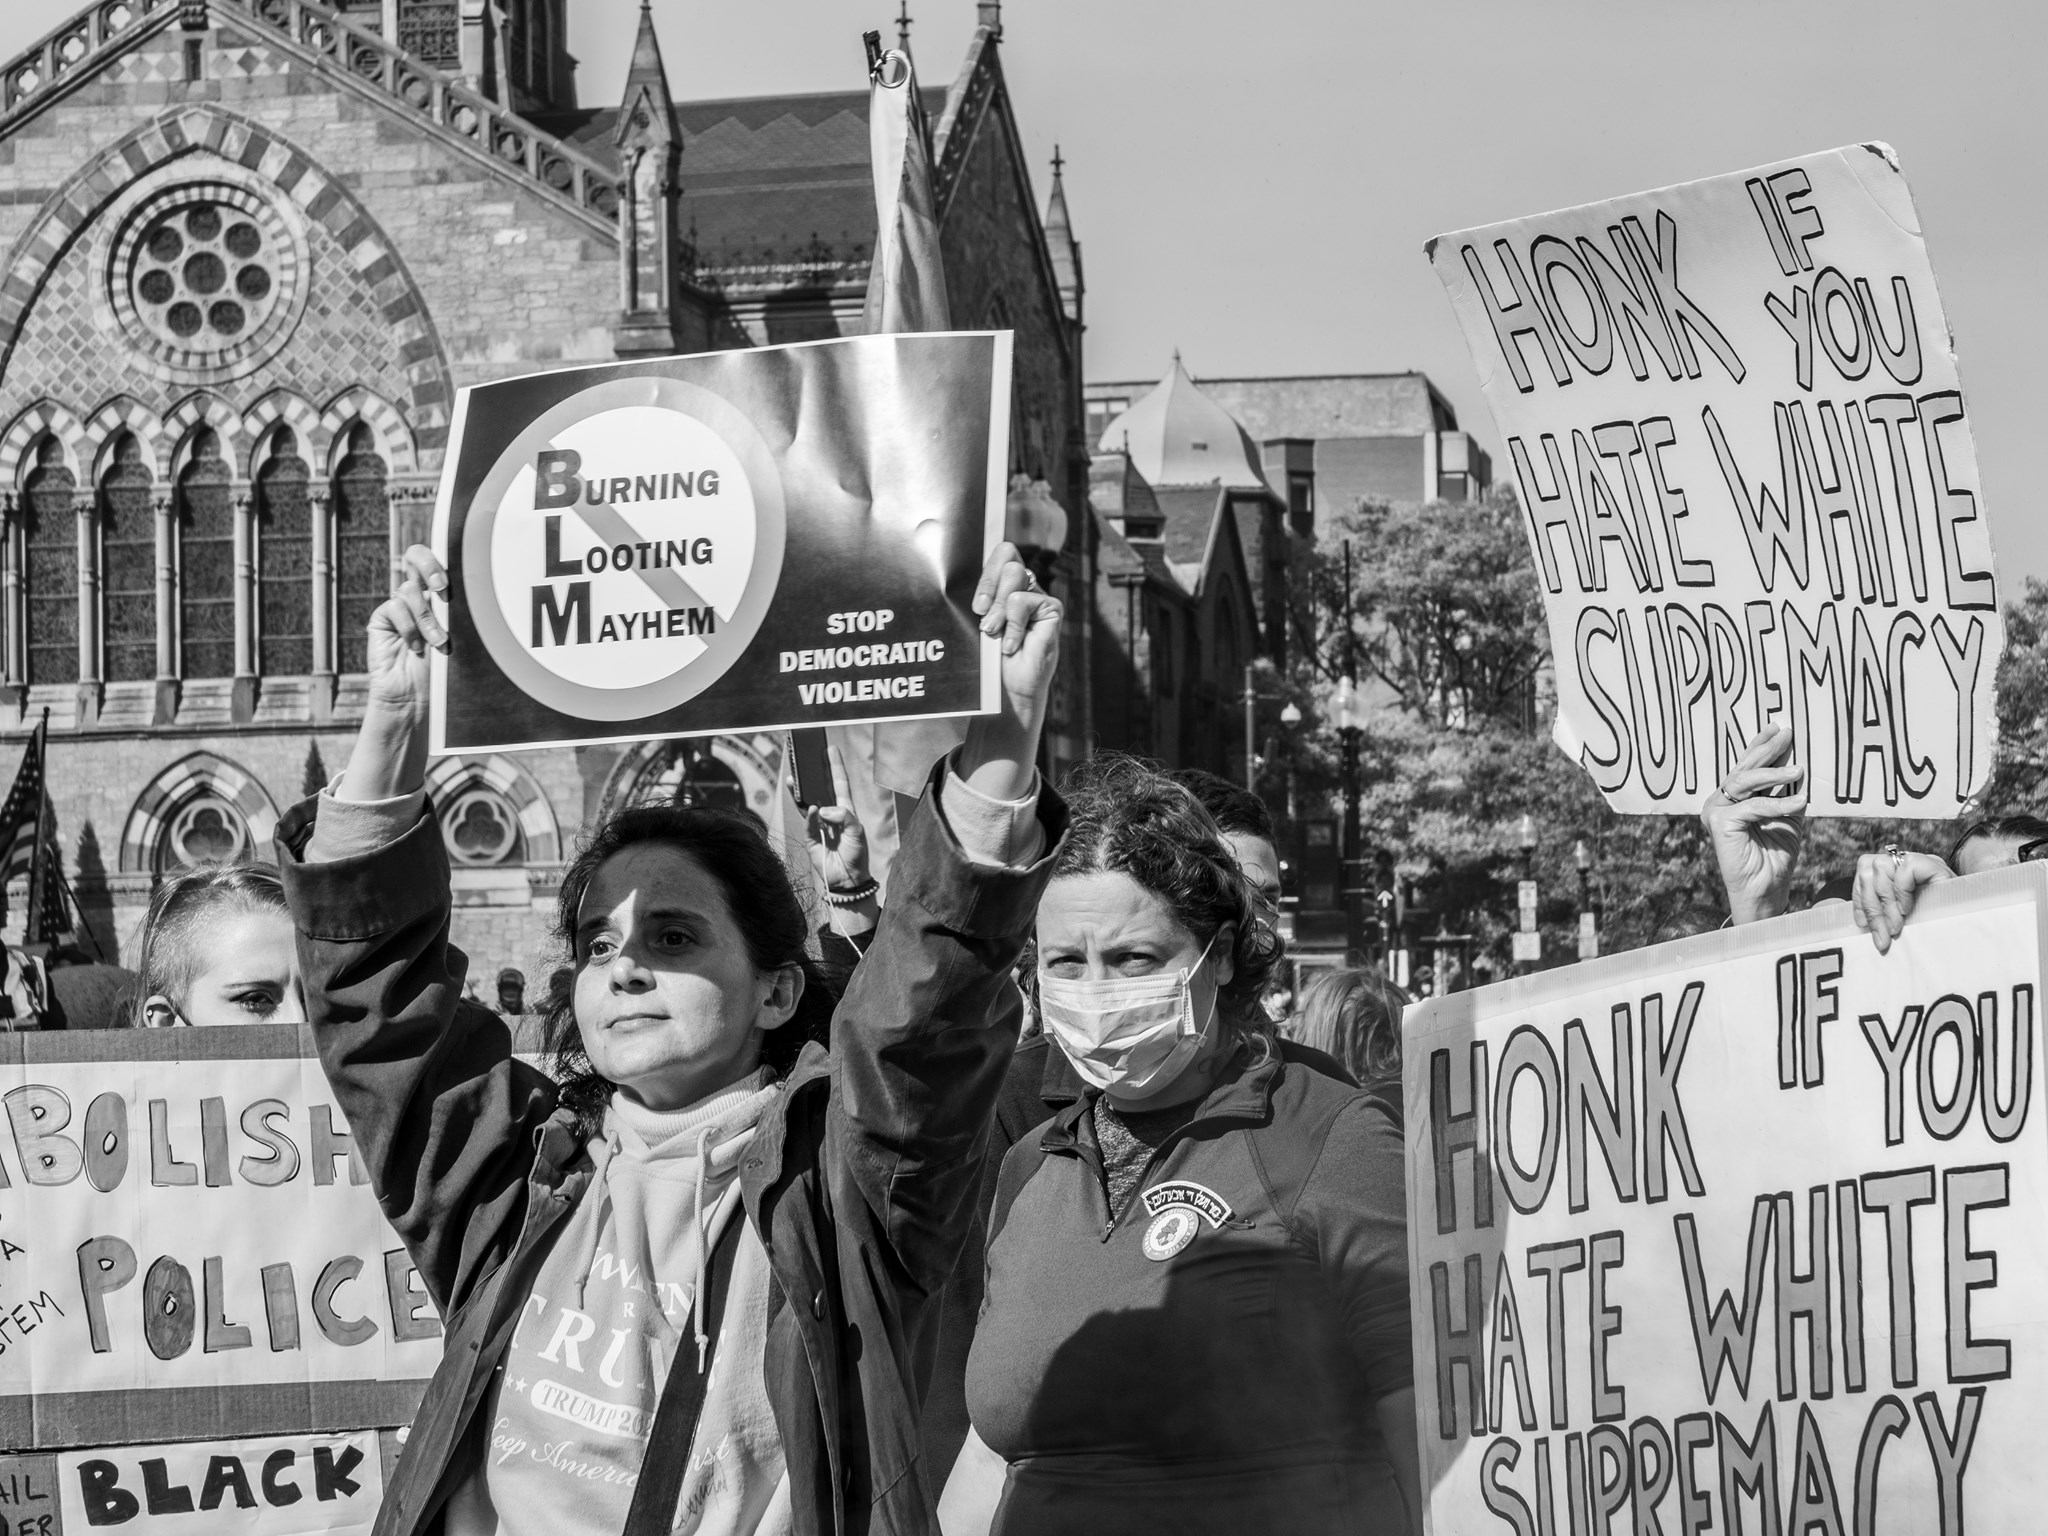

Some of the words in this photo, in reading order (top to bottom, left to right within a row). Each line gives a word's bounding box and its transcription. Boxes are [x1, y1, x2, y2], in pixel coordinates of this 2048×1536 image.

[1461, 209, 1746, 393] HONK
[1746, 168, 1824, 276] IF
[1764, 266, 1922, 391] YOU
[1508, 416, 1715, 593] HATE
[1702, 390, 1996, 612] WHITE
[779, 640, 945, 673] DEMOCRATIC
[826, 609, 894, 634] STOP
[798, 675, 925, 705] VIOLENCE
[1575, 600, 1984, 806] SUPREMACY
[0, 1084, 371, 1193] BOLISH
[1429, 981, 1706, 1235] HONK
[1776, 948, 1843, 1089] IF
[1859, 983, 2033, 1146] YOU
[77, 1235, 442, 1360] POLICE
[1429, 1230, 1626, 1440] HATE
[1673, 1162, 2012, 1405] WHITE
[77, 1446, 364, 1525] BLACK
